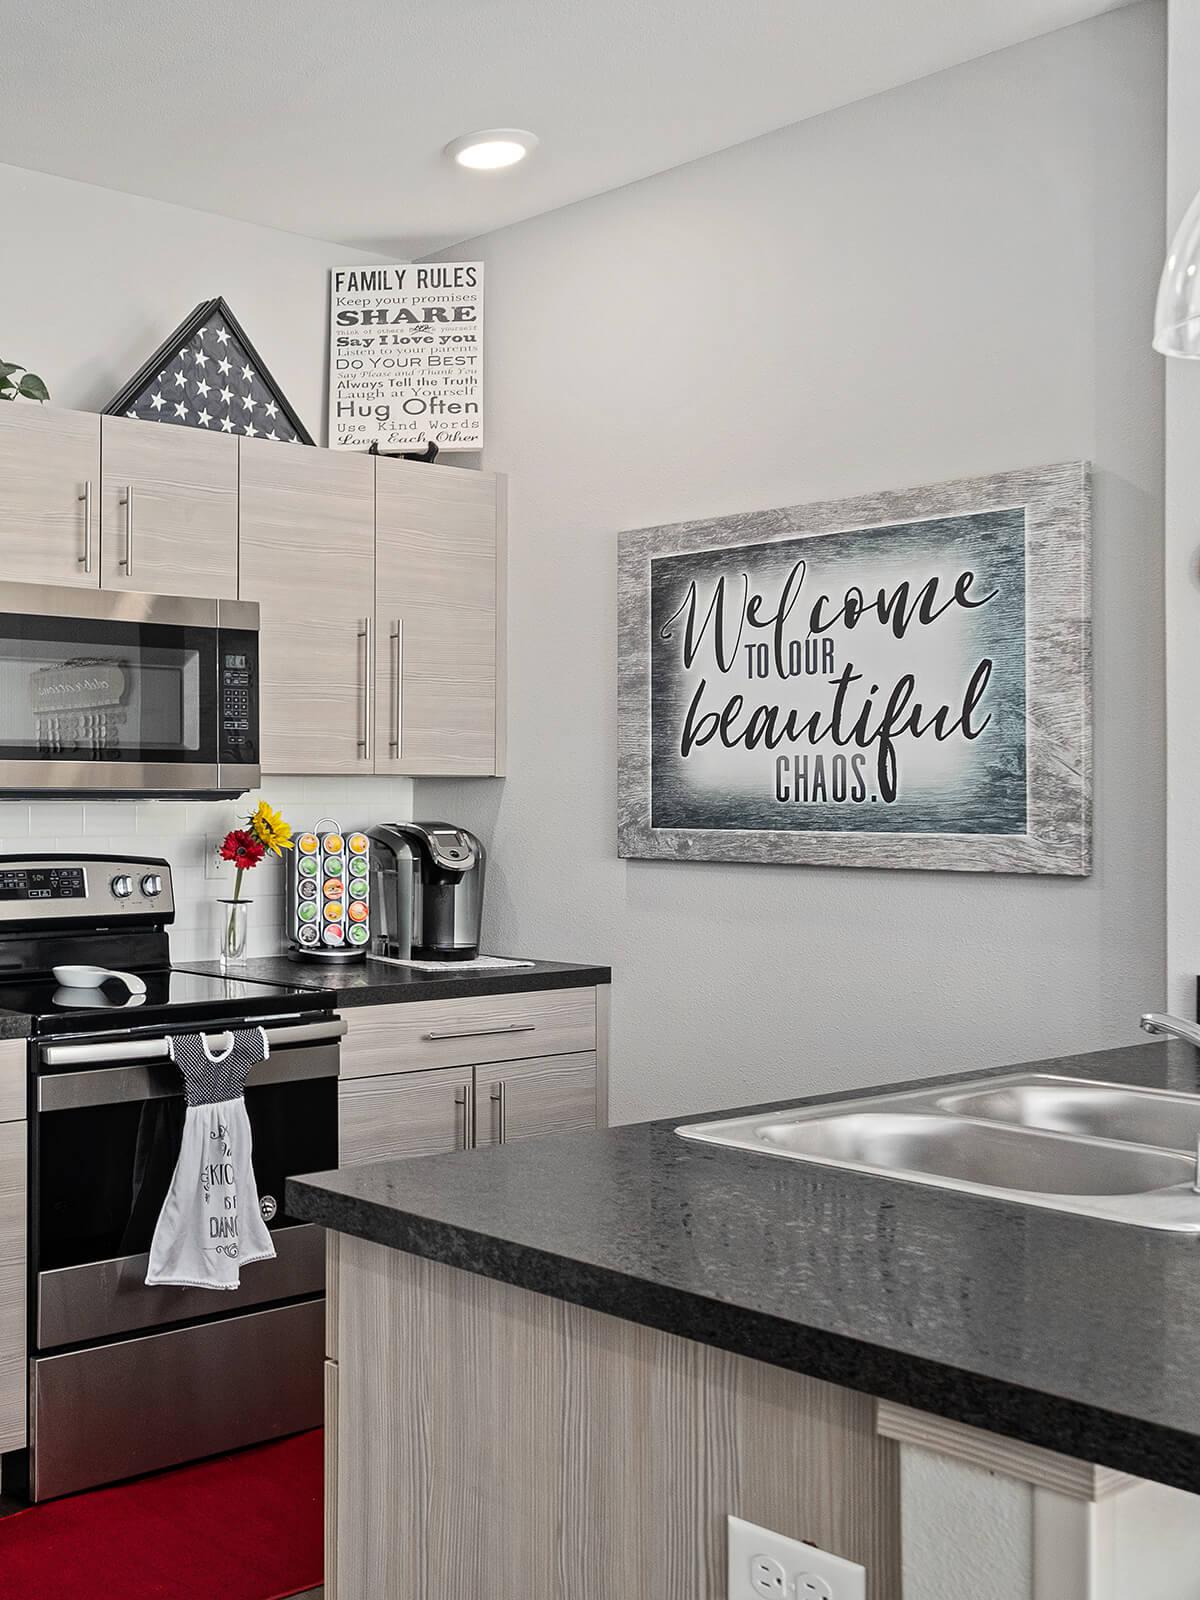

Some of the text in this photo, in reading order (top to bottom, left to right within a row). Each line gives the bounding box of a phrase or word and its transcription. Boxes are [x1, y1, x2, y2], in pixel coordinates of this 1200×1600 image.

[335, 266, 477, 292] FAMILY RULES
[336, 293, 478, 308] Keep your promises
[336, 306, 477, 327] SHARE
[336, 334, 477, 348] Say I love you
[337, 345, 478, 356] Listen to your parents
[337, 370, 357, 379] Say
[359, 370, 391, 378] Please
[337, 375, 478, 390] Always Tell the Truth
[337, 386, 478, 401] Laugh at Yourself
[336, 396, 478, 422] Hug Often
[337, 419, 479, 432] Use Kind Words
[337, 430, 479, 446] Love Each Other
[661, 560, 999, 680] Welcome
[744, 637, 834, 680] TO OUR
[680, 658, 993, 803] beautiful
[775, 753, 878, 803] CHAOS.
